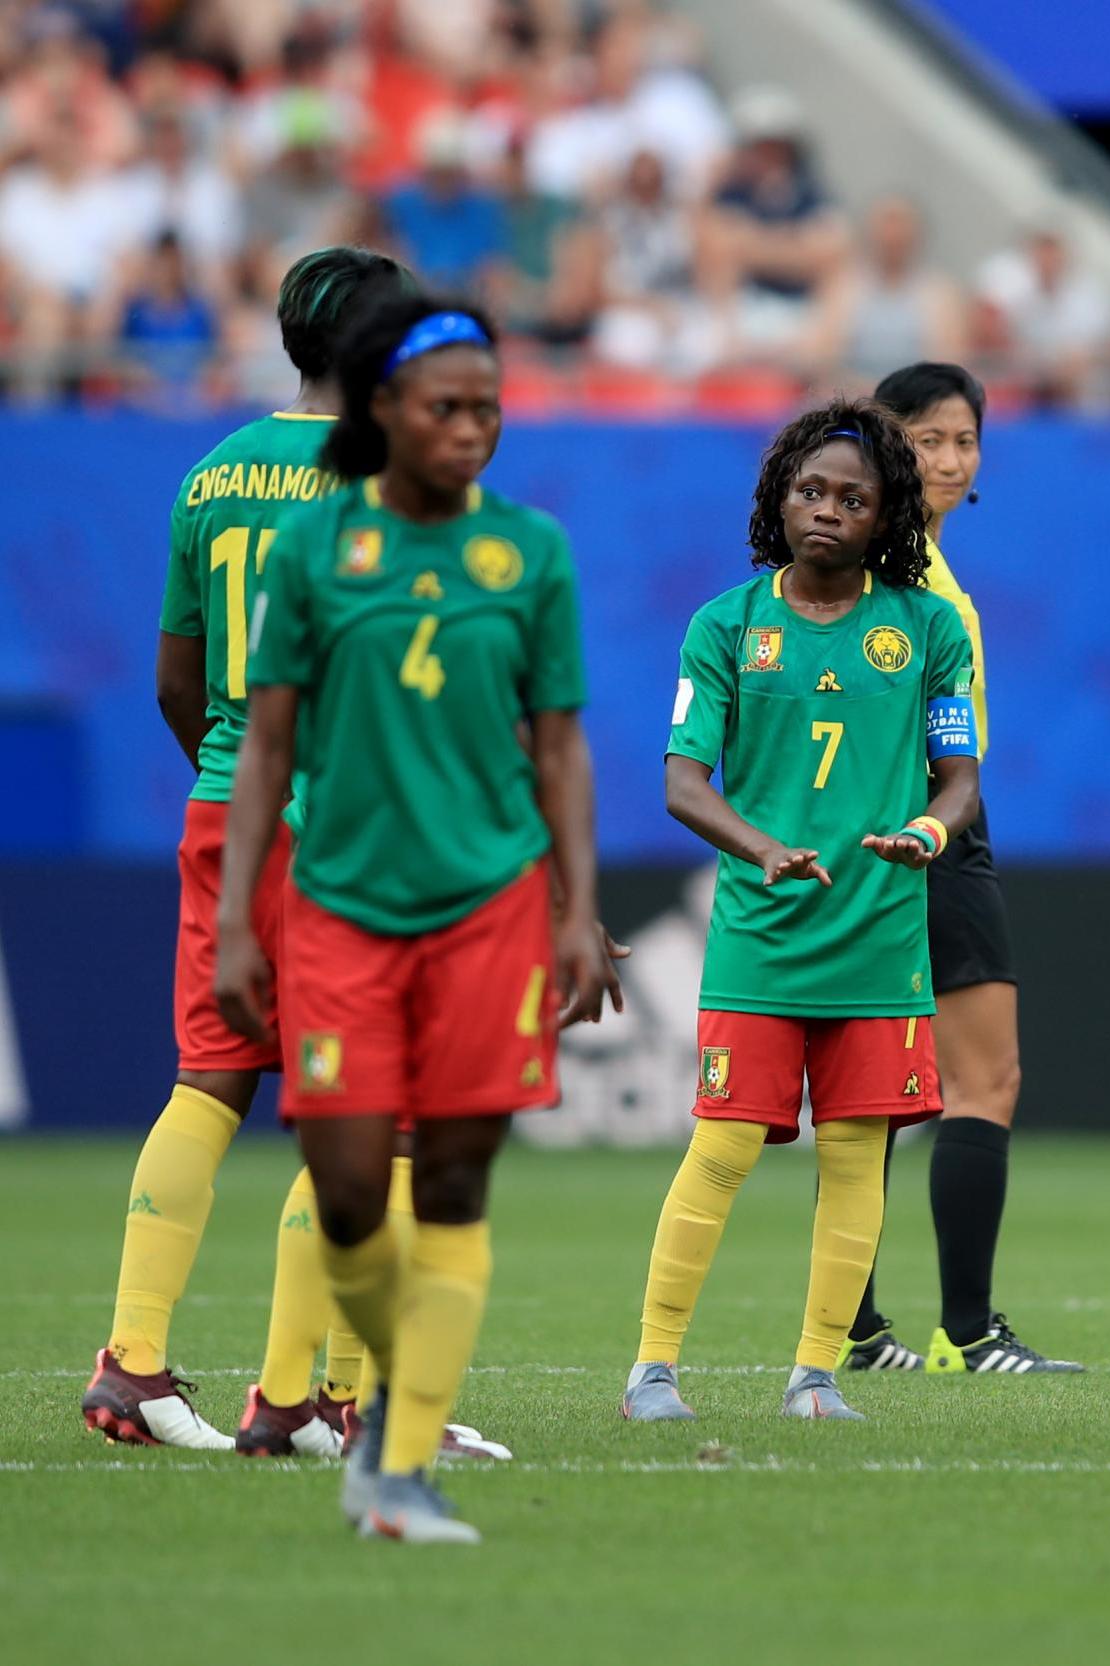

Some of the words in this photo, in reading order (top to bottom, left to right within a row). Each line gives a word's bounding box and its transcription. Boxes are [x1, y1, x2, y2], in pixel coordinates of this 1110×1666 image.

[210, 526, 279, 700] 1
[400, 613, 445, 700] 4
[811, 720, 844, 790] 7
[941, 733, 970, 746] FIFA
